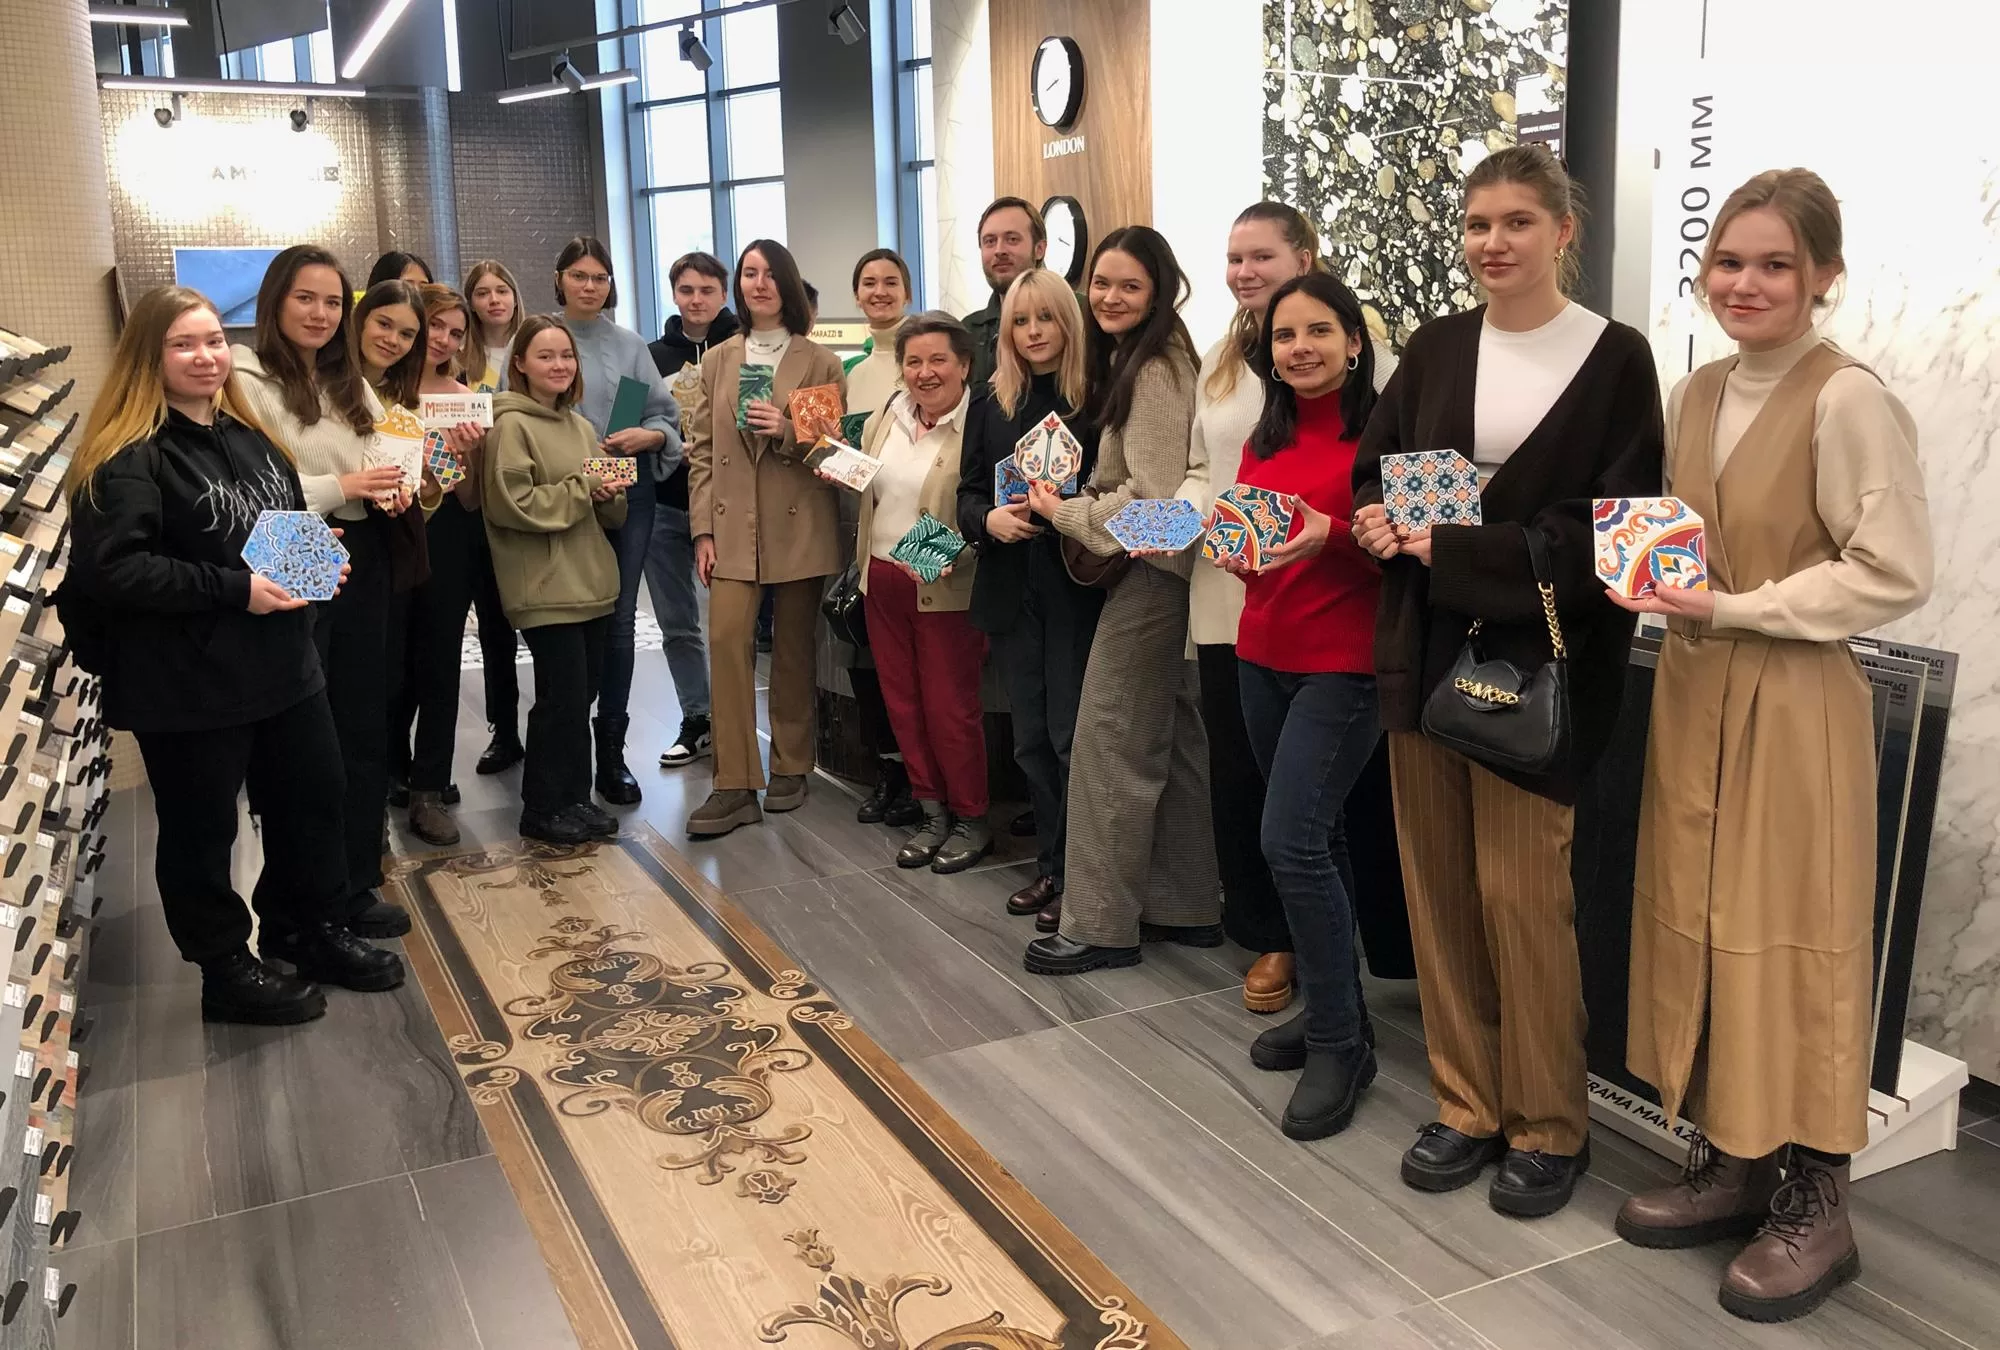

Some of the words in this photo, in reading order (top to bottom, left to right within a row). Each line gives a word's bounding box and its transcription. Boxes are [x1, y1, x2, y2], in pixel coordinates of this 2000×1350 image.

[1042, 135, 1085, 159] LONDON
[1690, 95, 1713, 169] MM
[1678, 186, 1711, 299] 3200
[471, 402, 487, 410] BAL
[1587, 1079, 1633, 1110] RAMA
